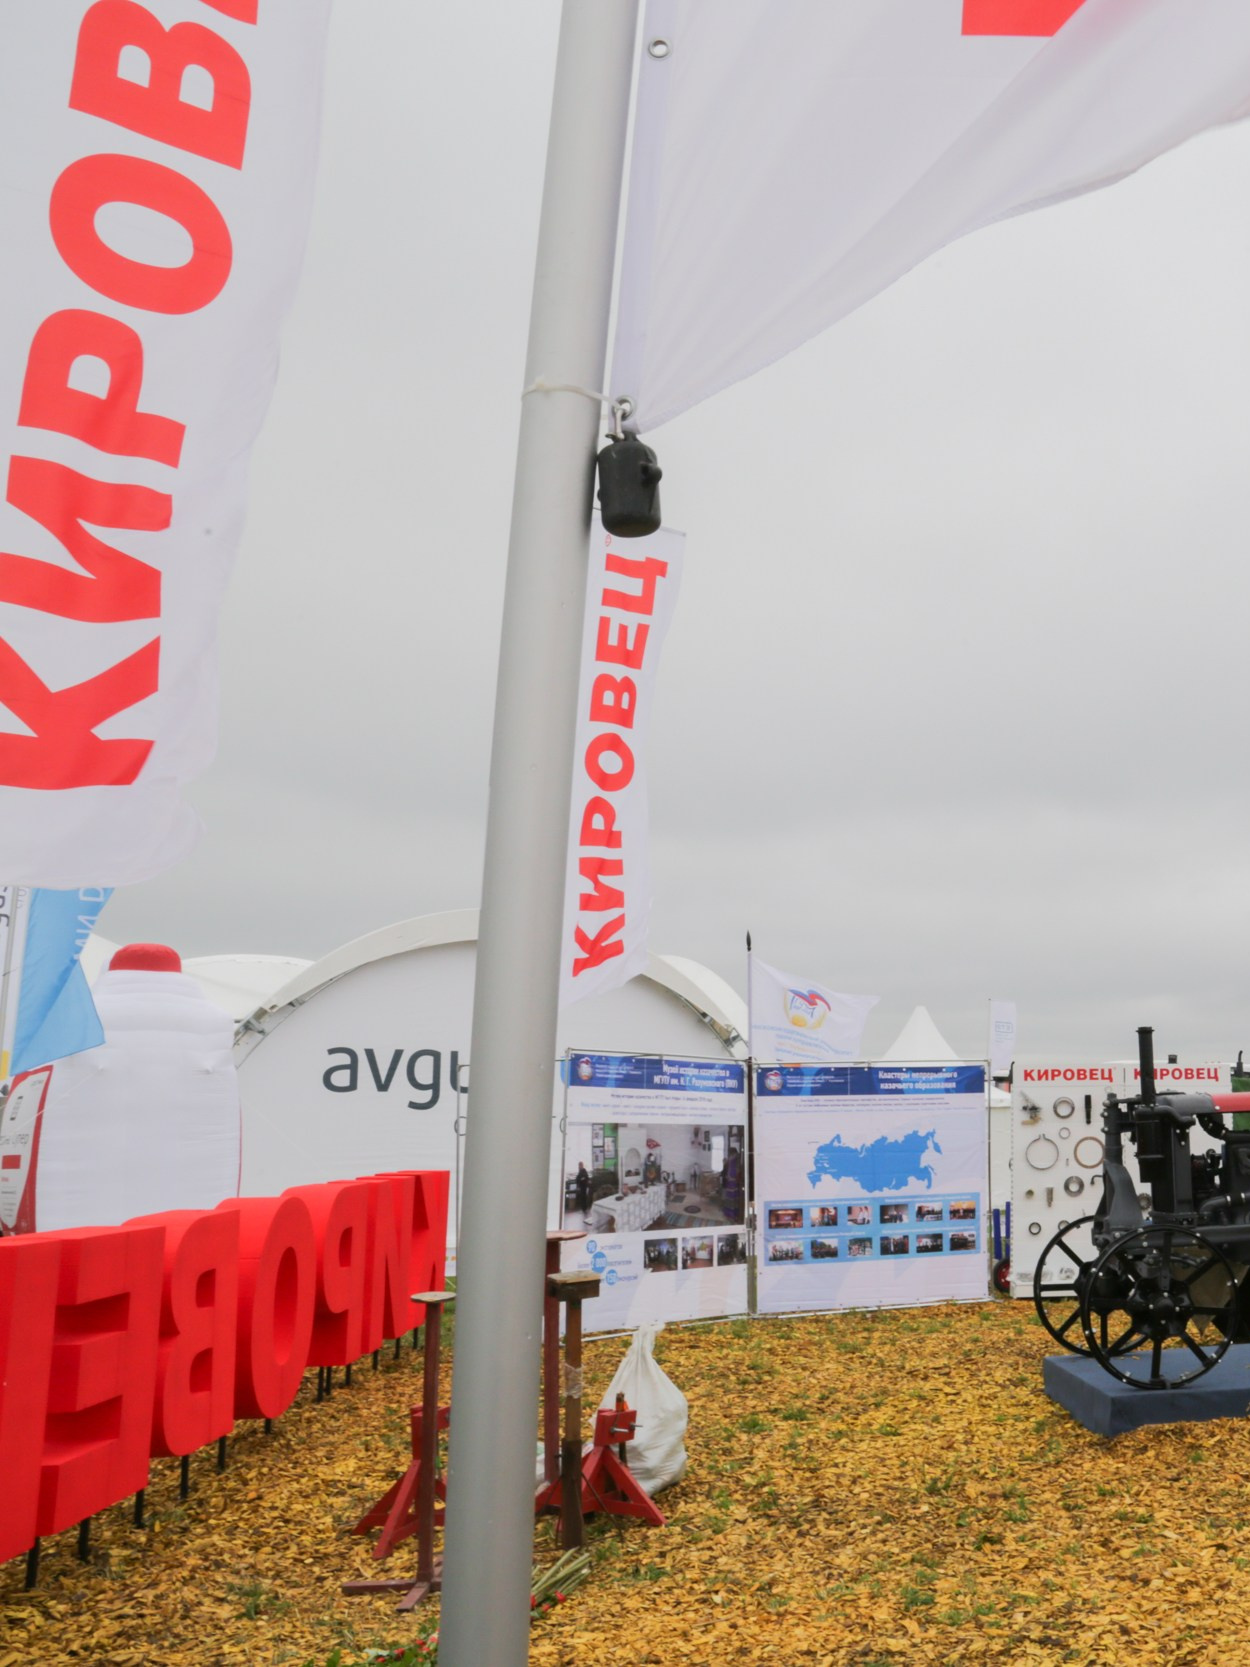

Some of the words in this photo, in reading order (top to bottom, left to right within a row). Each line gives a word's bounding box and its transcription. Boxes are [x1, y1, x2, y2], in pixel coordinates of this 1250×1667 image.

[0, 0, 258, 790] КИРОВ
[572, 553, 669, 978] КИРОВЕЦ
[1023, 1068, 1114, 1083] КИРОВЕЦ
